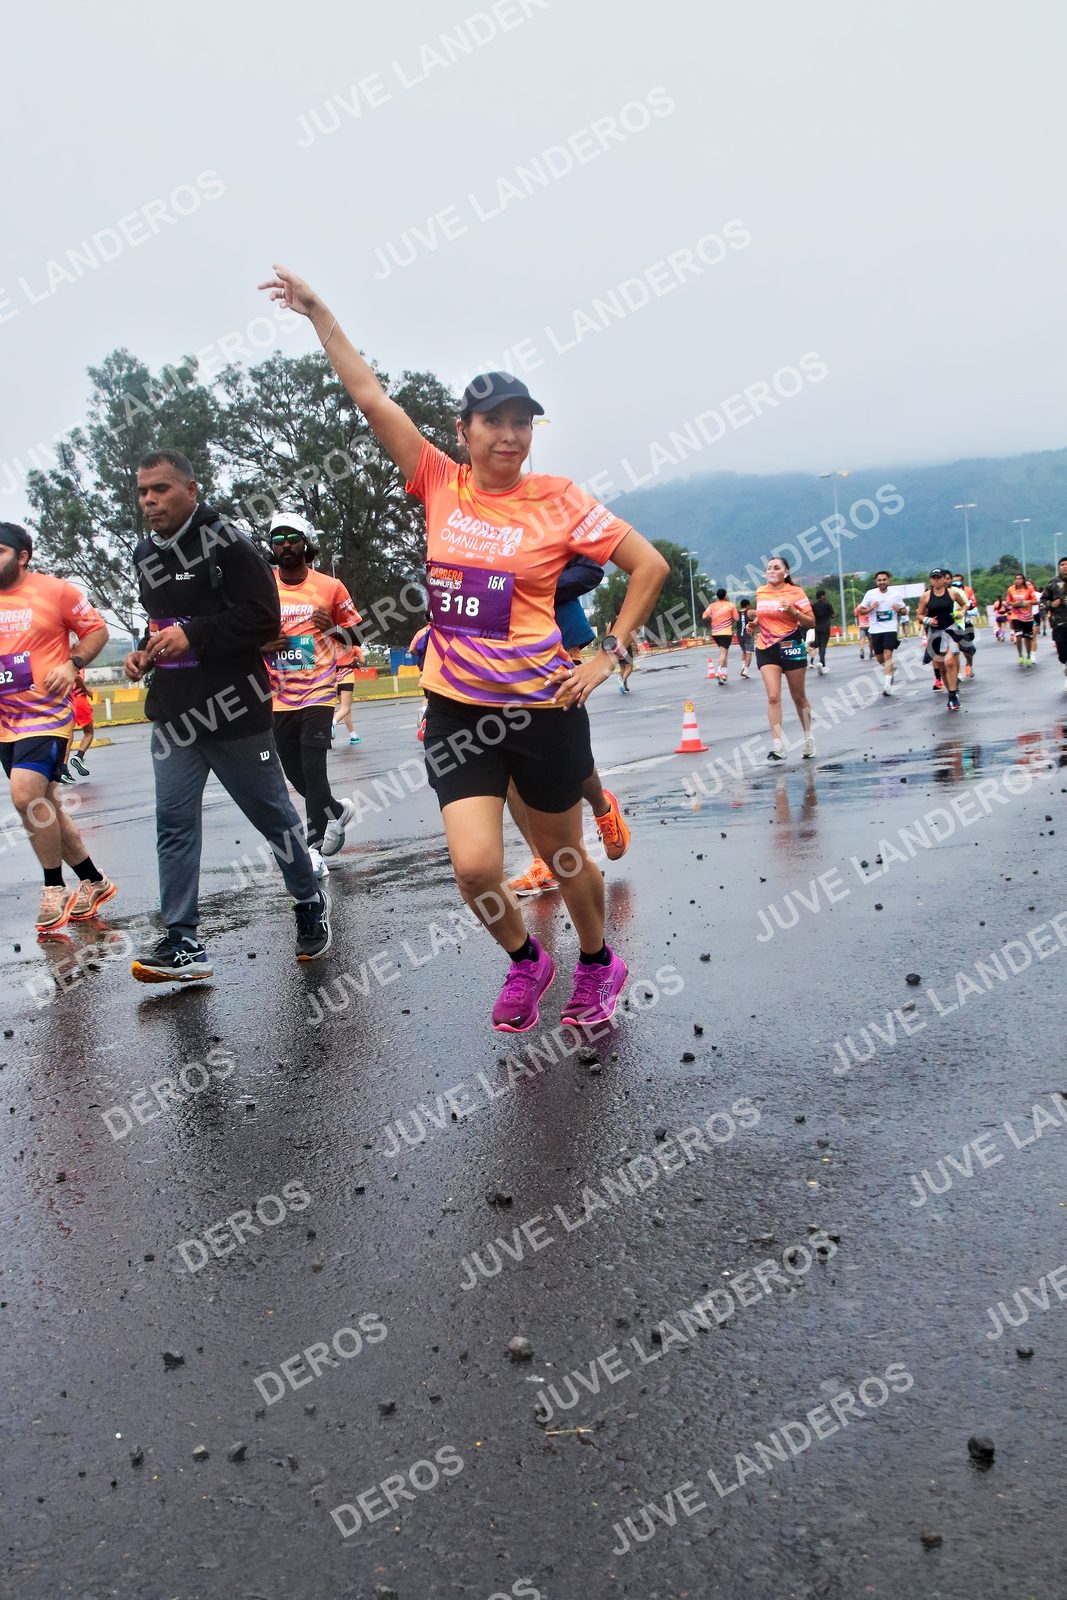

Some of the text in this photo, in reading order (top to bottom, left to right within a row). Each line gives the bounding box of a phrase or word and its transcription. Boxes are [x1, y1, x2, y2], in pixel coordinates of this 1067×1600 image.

[448, 508, 524, 545] CARRERA
[440, 528, 499, 554] OMNILIFE
[440, 592, 480, 616] 318
[14, 655, 25, 664] 15K
[276, 650, 302, 660] 1066
[784, 648, 801, 656] 1502
